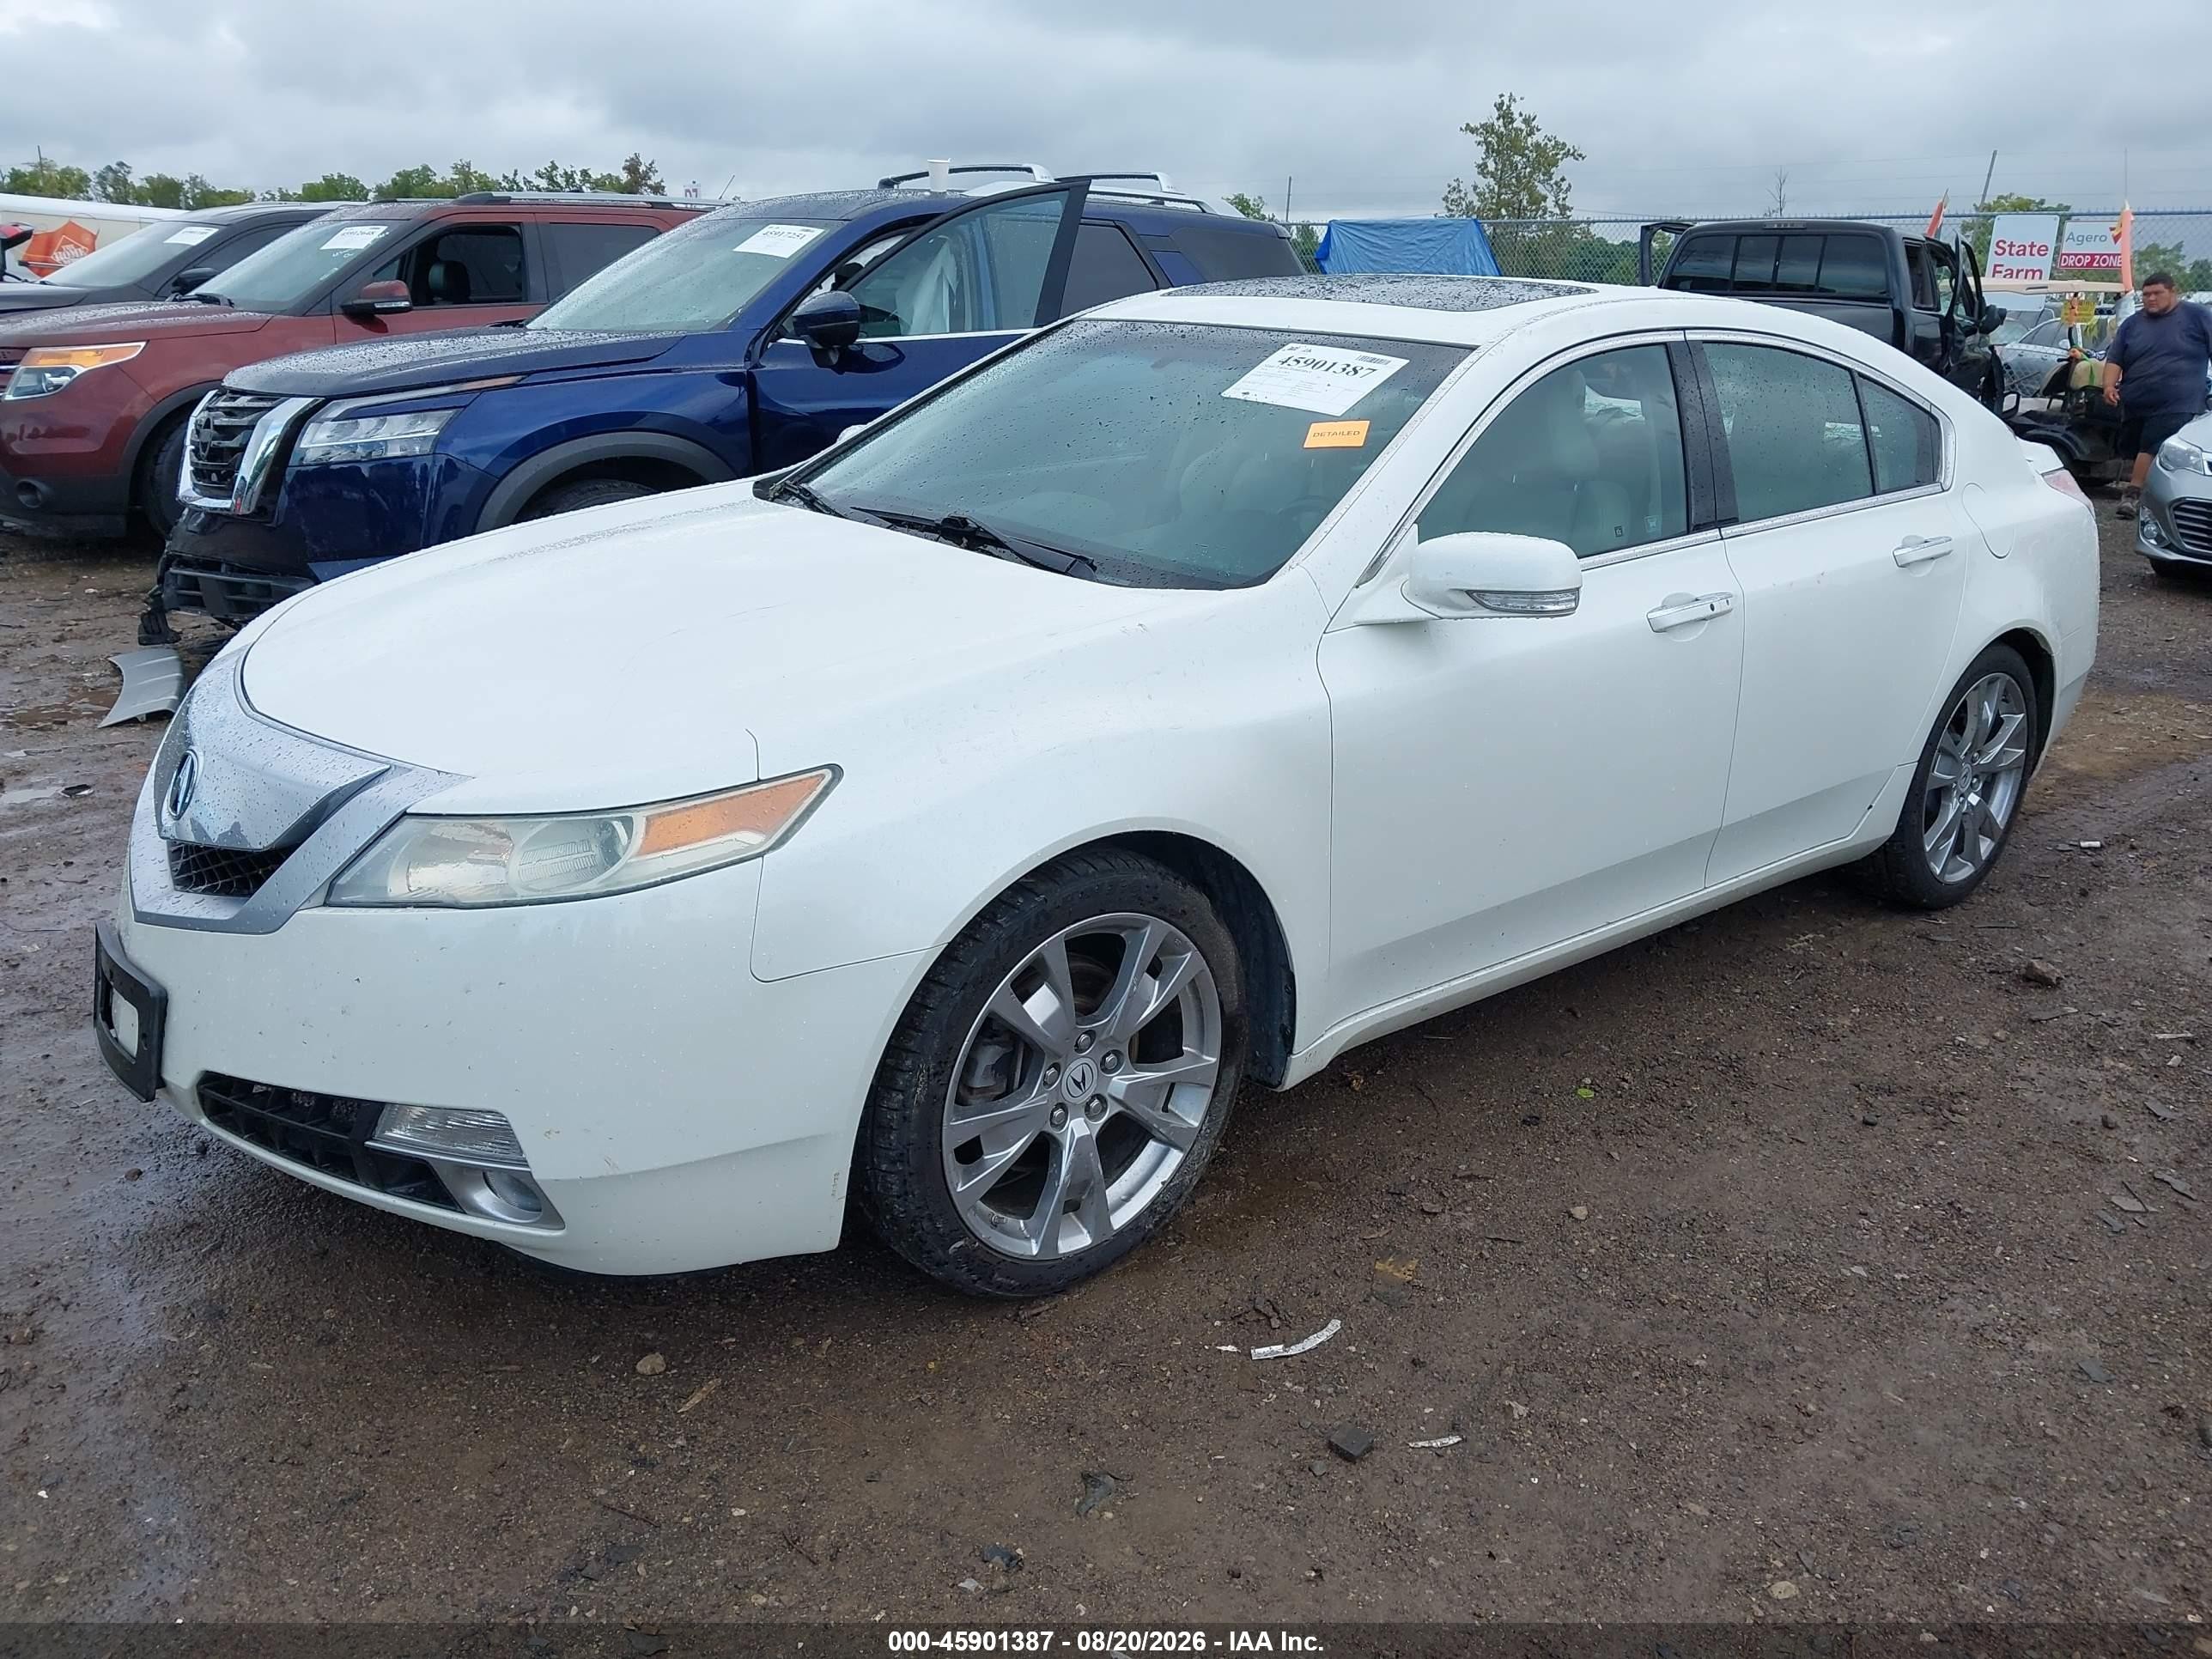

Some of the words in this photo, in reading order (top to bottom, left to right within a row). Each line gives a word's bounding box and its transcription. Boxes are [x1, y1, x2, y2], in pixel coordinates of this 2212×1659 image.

[2065, 232, 2108, 246] Agero
[1994, 240, 2049, 257] State
[2061, 255, 2092, 267] DROP
[1991, 264, 2044, 280] Farm
[1277, 355, 1380, 379] 45901387
